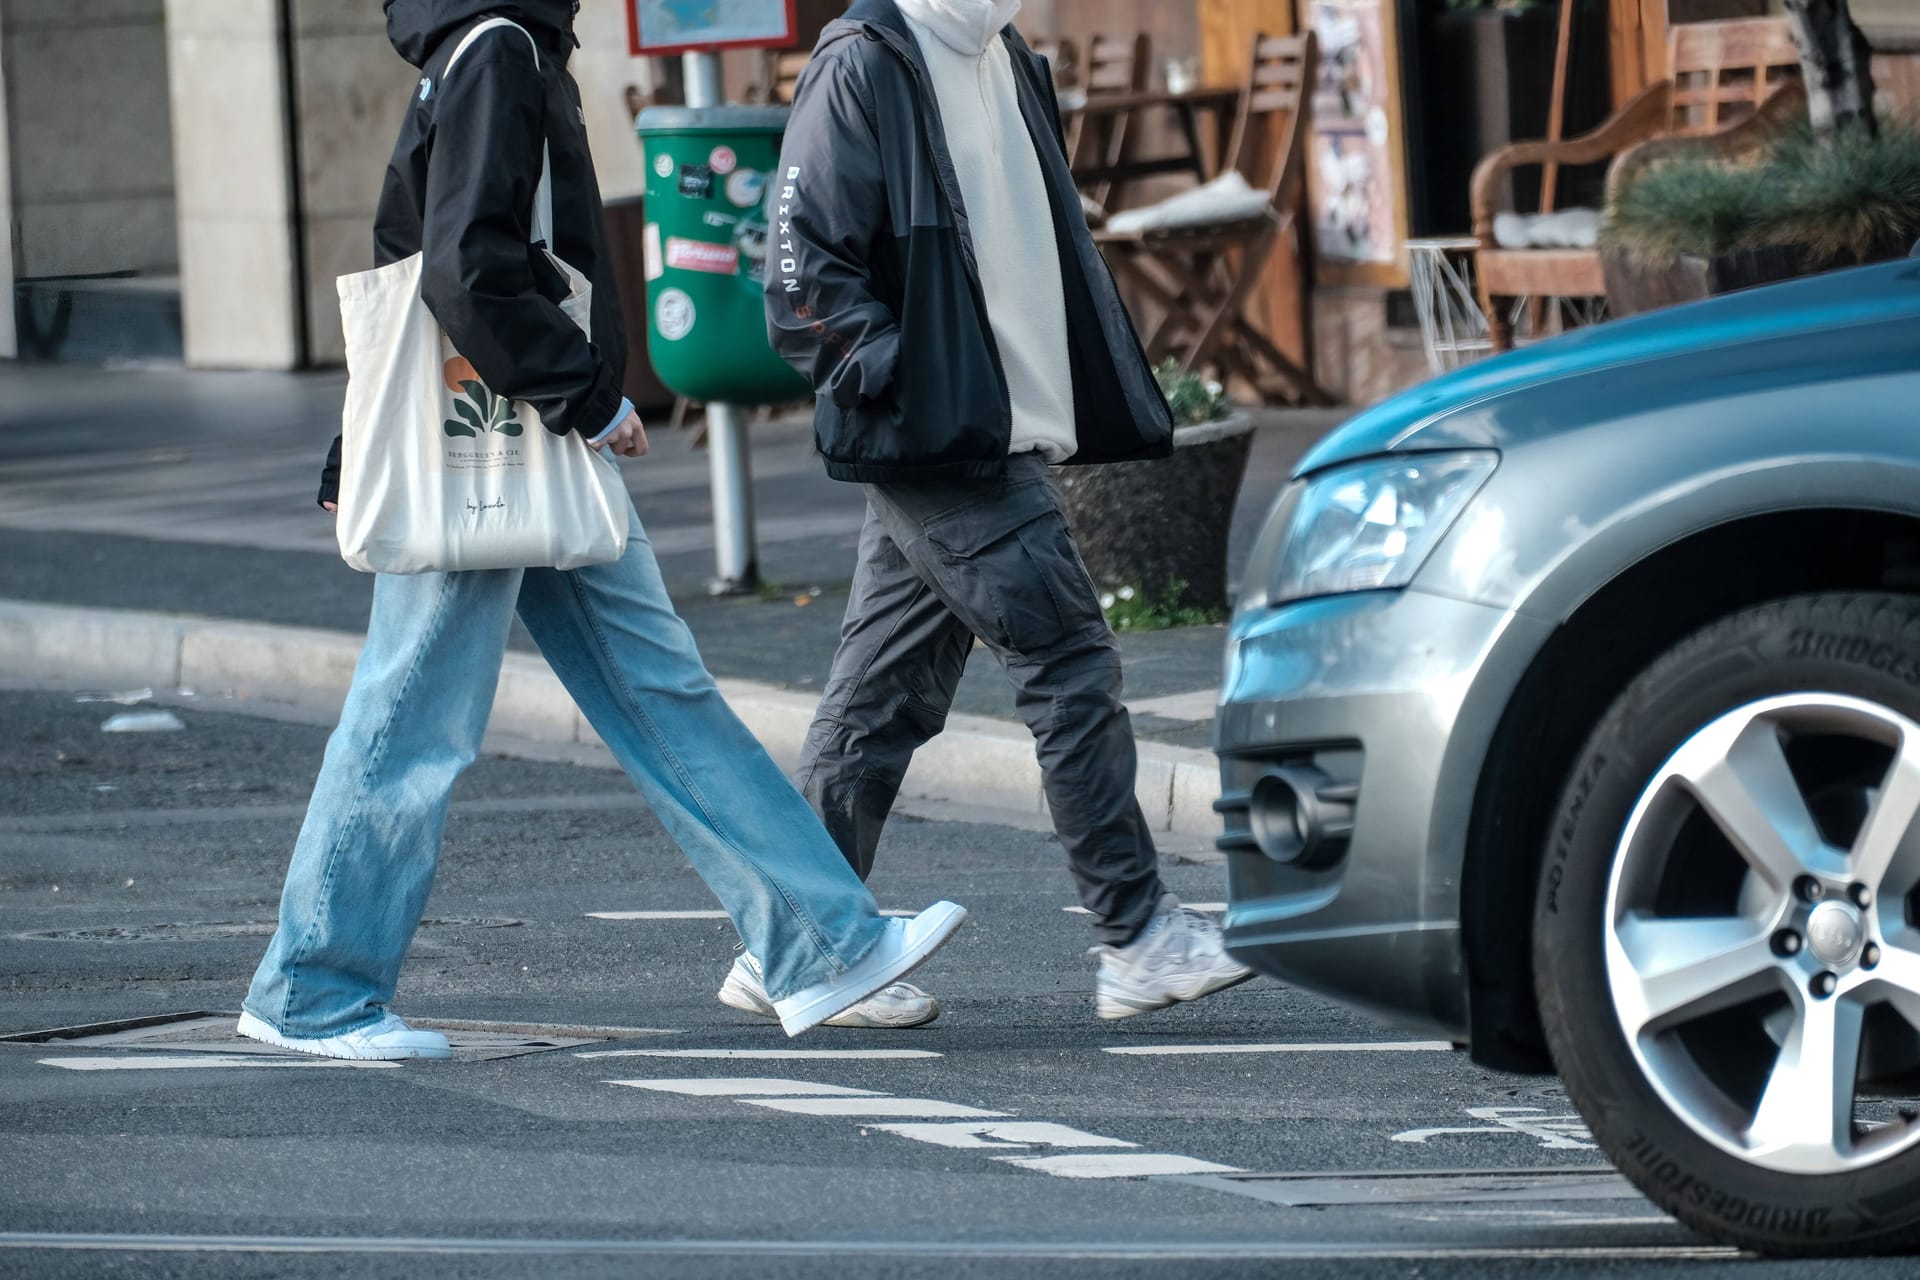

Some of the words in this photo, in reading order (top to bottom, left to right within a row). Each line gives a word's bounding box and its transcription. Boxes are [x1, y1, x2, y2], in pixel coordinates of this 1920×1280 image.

[778, 165, 801, 293] BRIXTON
[1548, 753, 1607, 915] POTENZA
[1625, 1127, 1834, 1237] BRIDGESTONE
